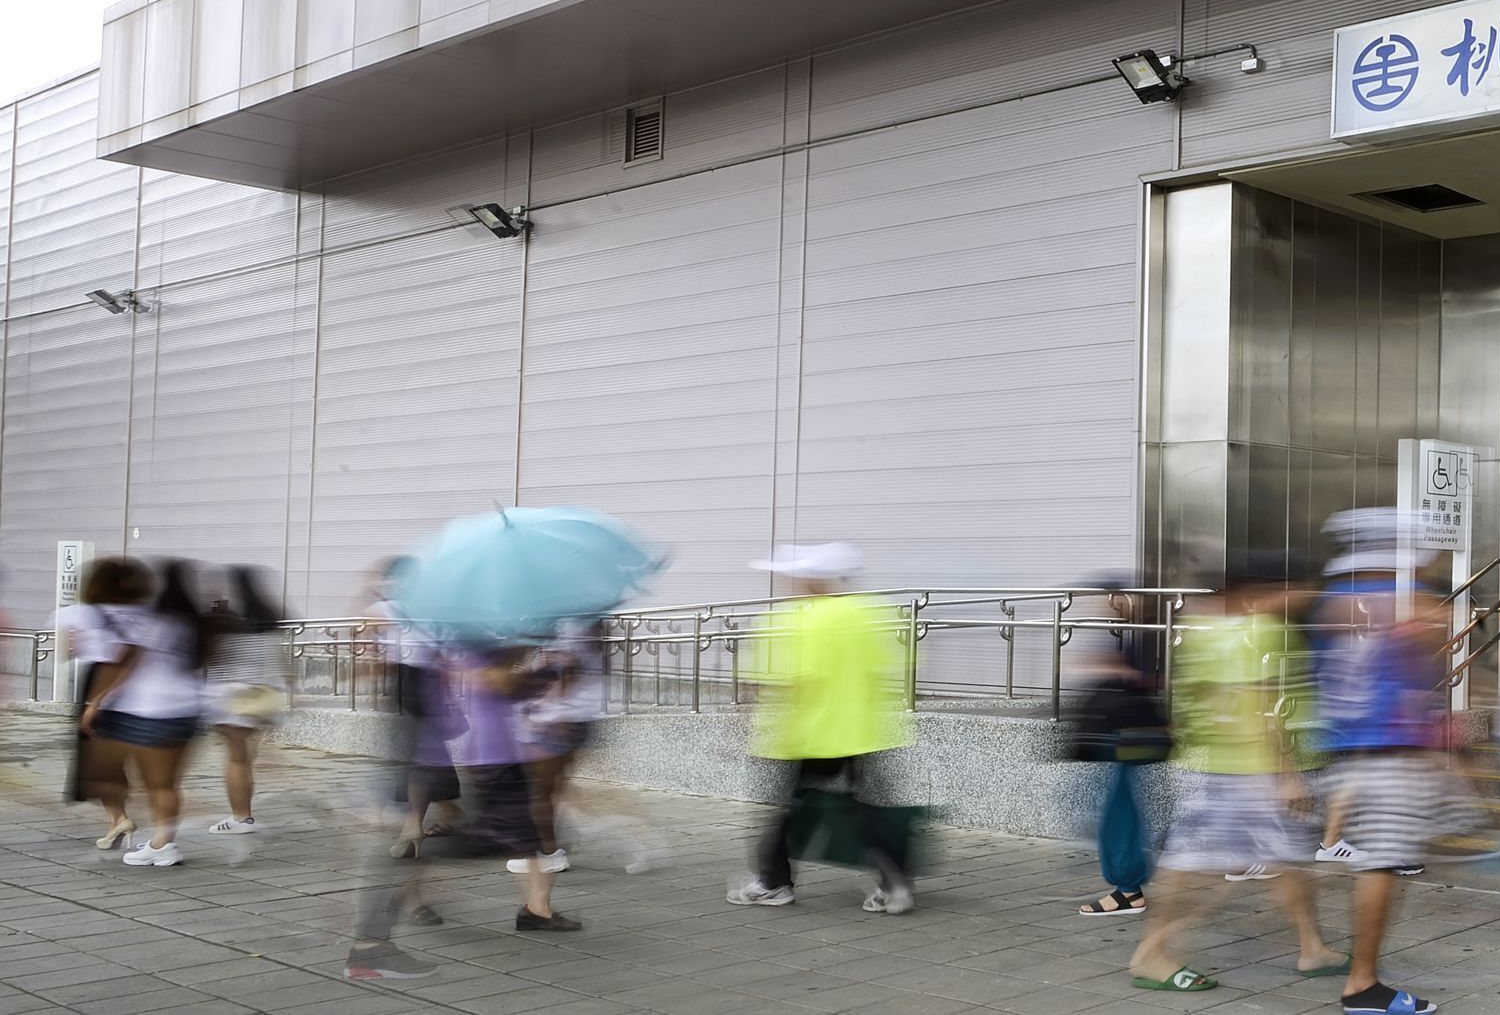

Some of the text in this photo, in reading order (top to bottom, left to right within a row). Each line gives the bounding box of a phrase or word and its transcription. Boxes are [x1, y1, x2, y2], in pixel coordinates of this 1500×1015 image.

[1422, 499, 1461, 513] 無障礙
[1425, 526, 1457, 535] Wheelchair
[1423, 535, 1458, 544] Passageway
